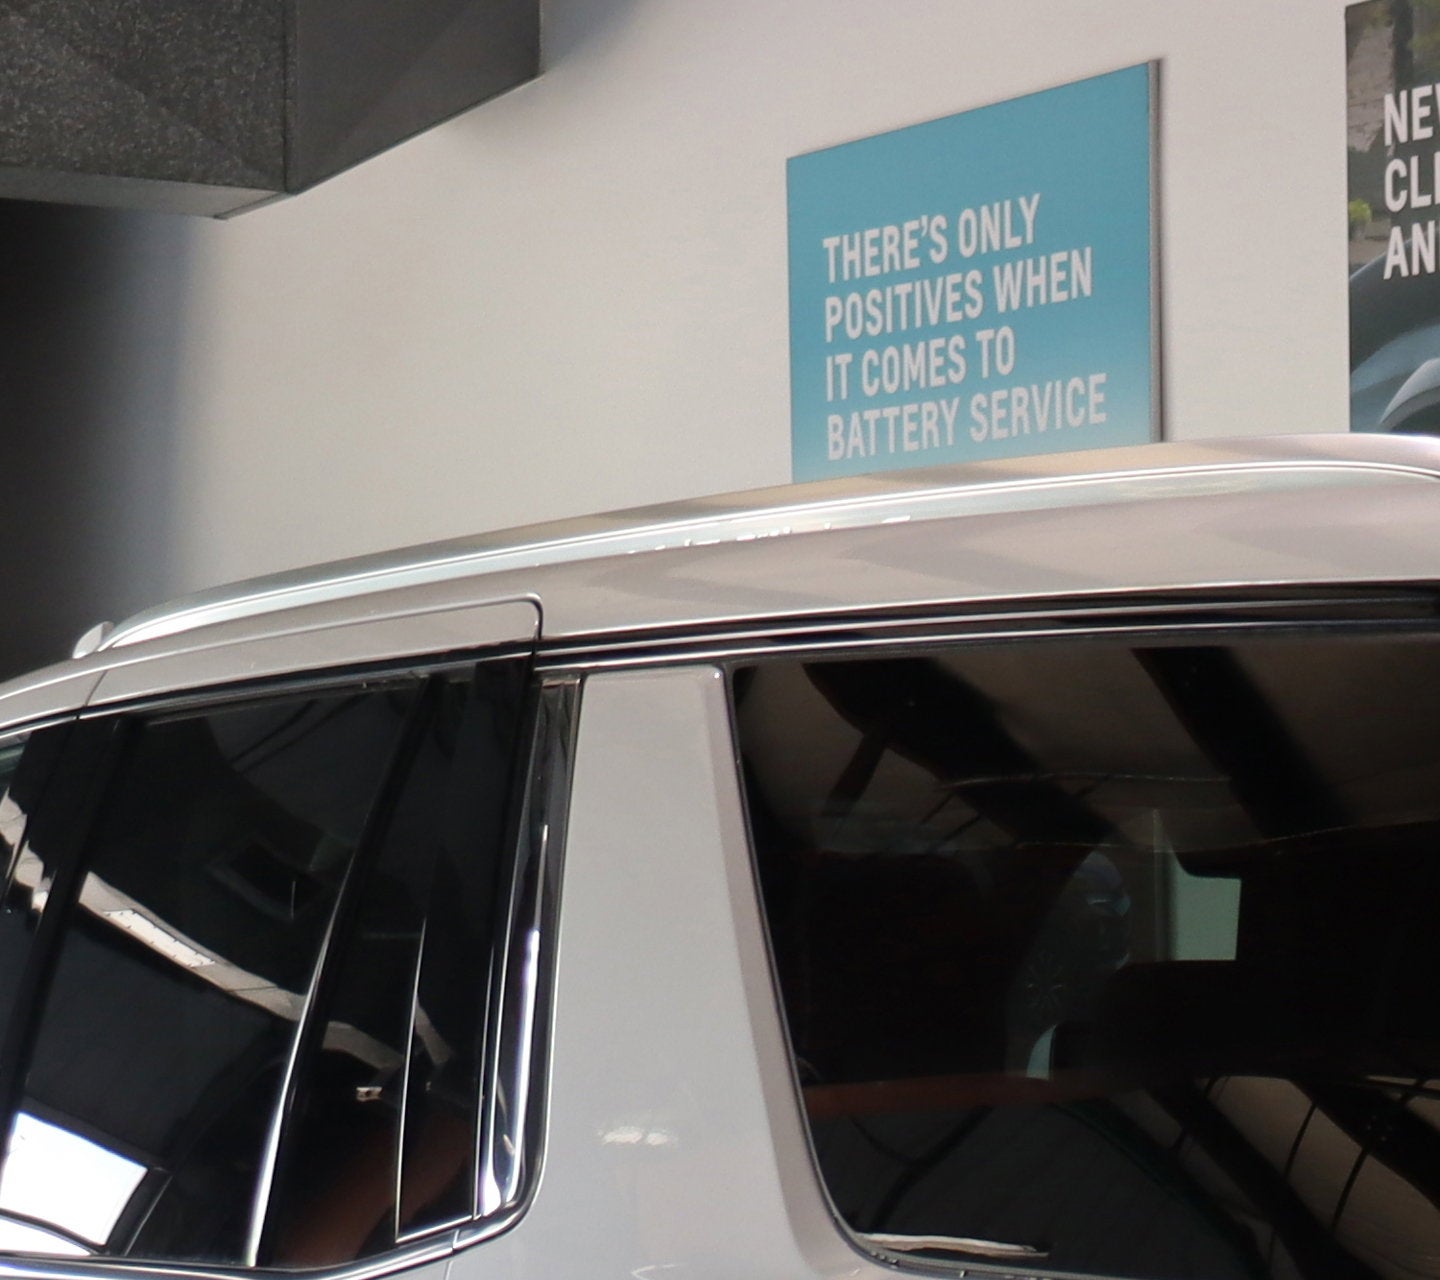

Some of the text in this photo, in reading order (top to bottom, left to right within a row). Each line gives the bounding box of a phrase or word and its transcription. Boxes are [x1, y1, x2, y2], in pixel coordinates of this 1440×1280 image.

[822, 192, 1041, 284] THERE'S ONLY
[825, 245, 1093, 343] POSITIVES WHEN
[826, 325, 1016, 402] IT COMES TO
[827, 372, 1108, 461] BATTERY SERVICE
